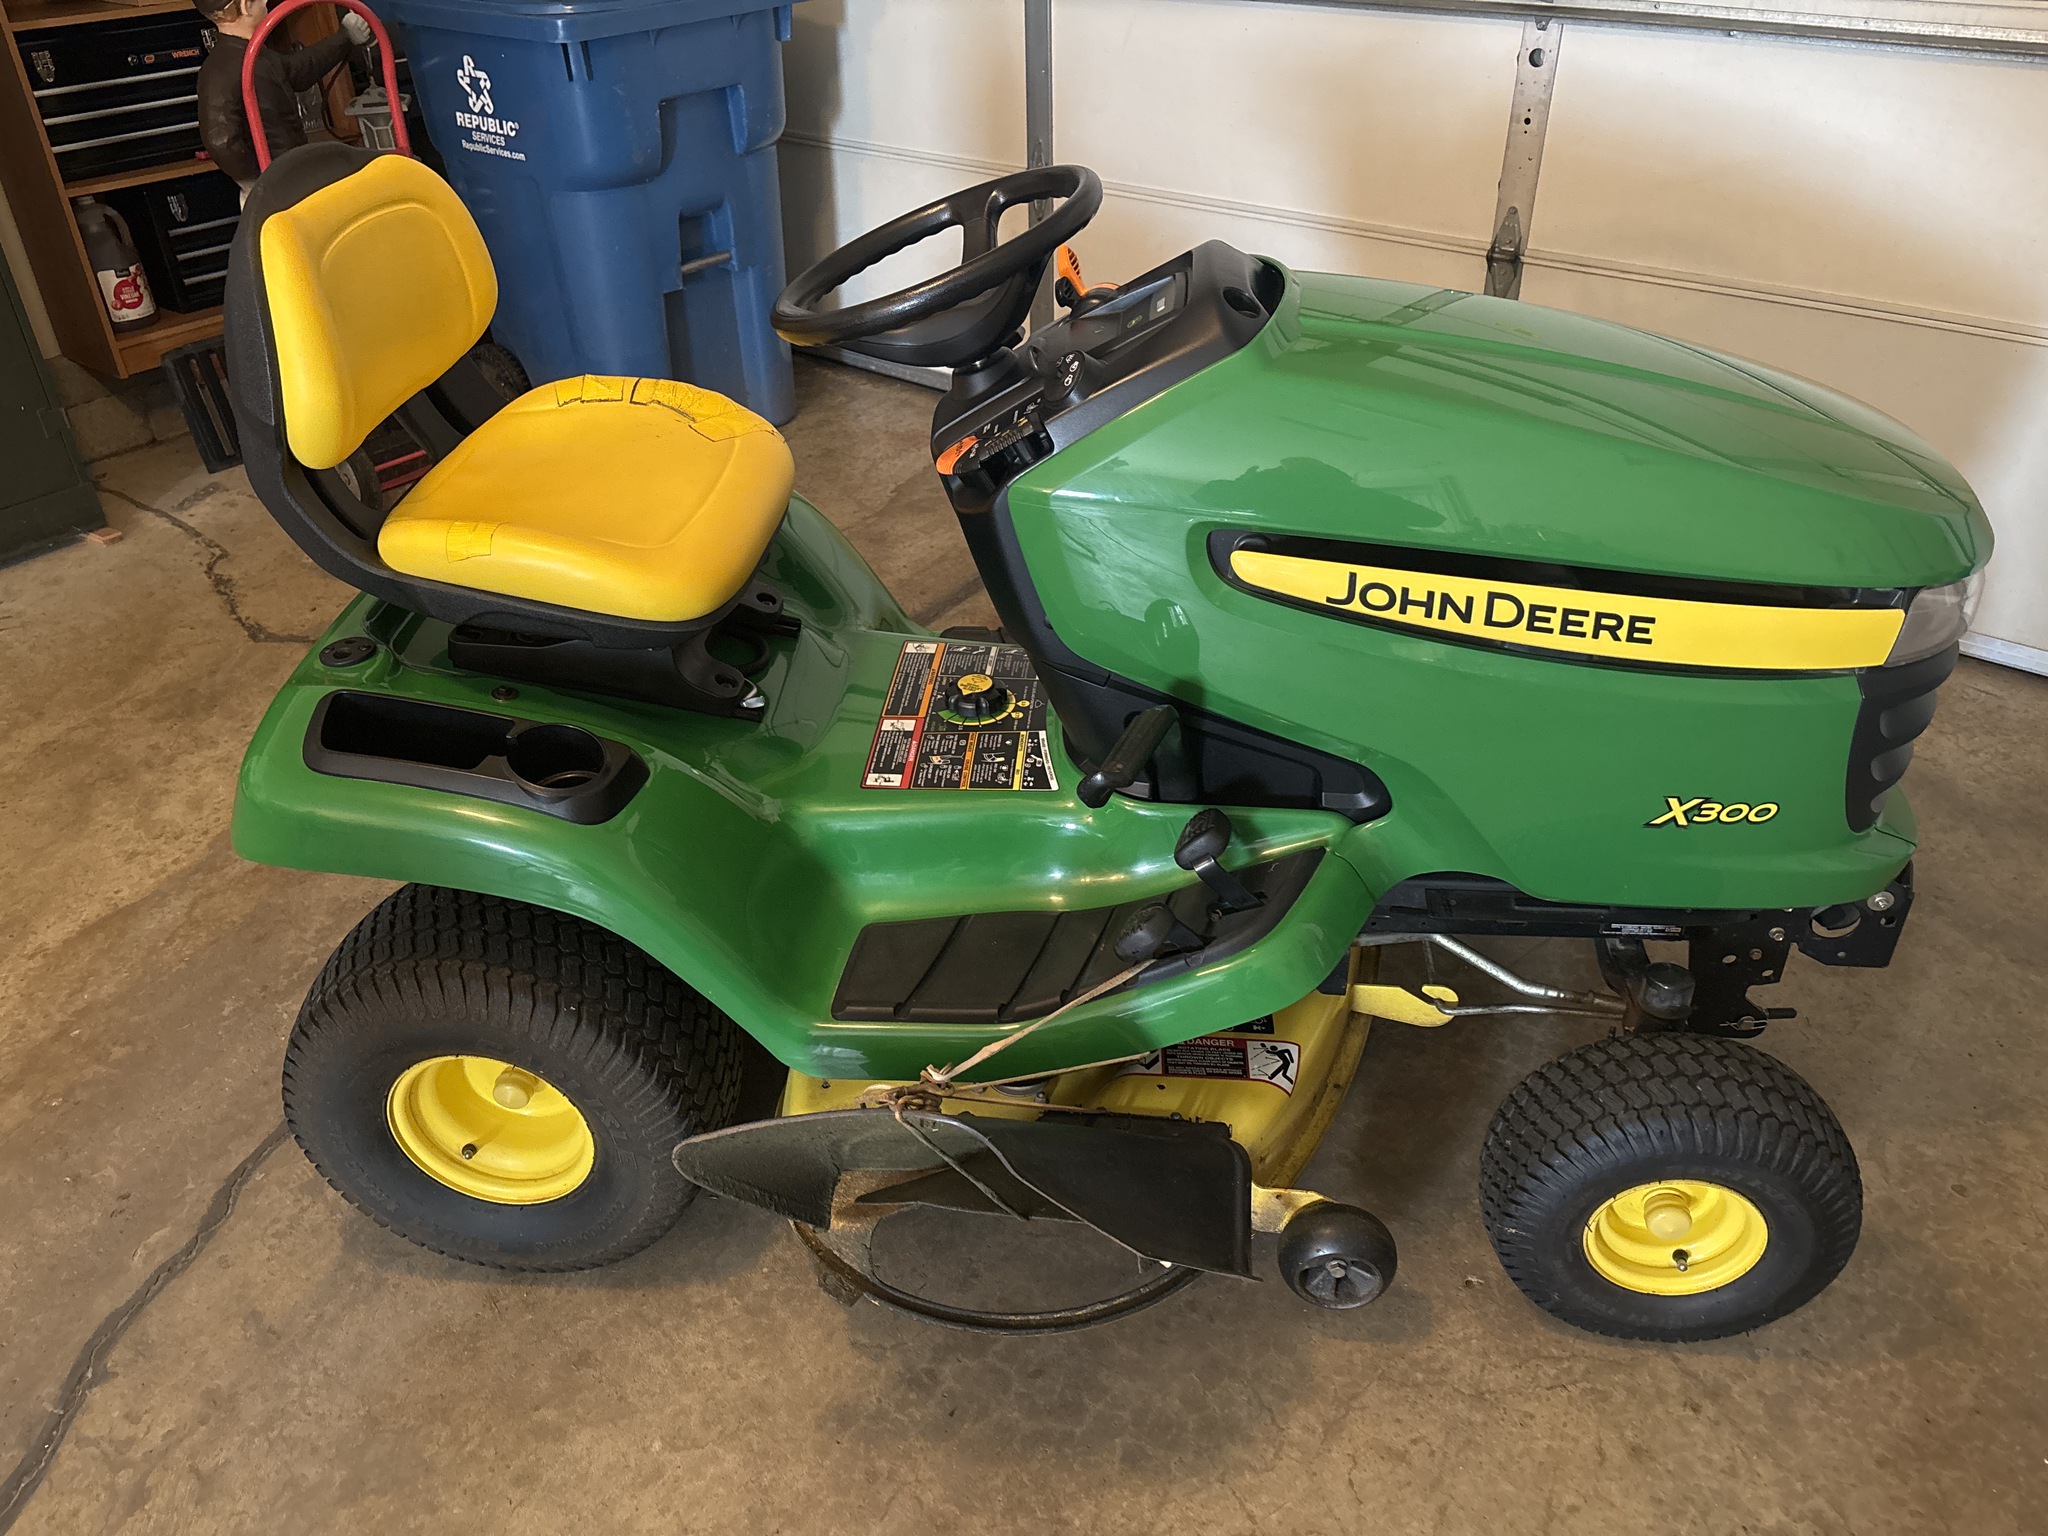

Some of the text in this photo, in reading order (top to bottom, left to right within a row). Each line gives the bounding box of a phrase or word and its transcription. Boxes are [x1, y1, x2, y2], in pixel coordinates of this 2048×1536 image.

[472, 131, 506, 146] SERVICES
[462, 140, 526, 161] RepublicServices.com
[1326, 572, 1656, 645] JOHN DEERE
[1644, 796, 1780, 827] X300
[1187, 1038, 1235, 1047] DANGER
